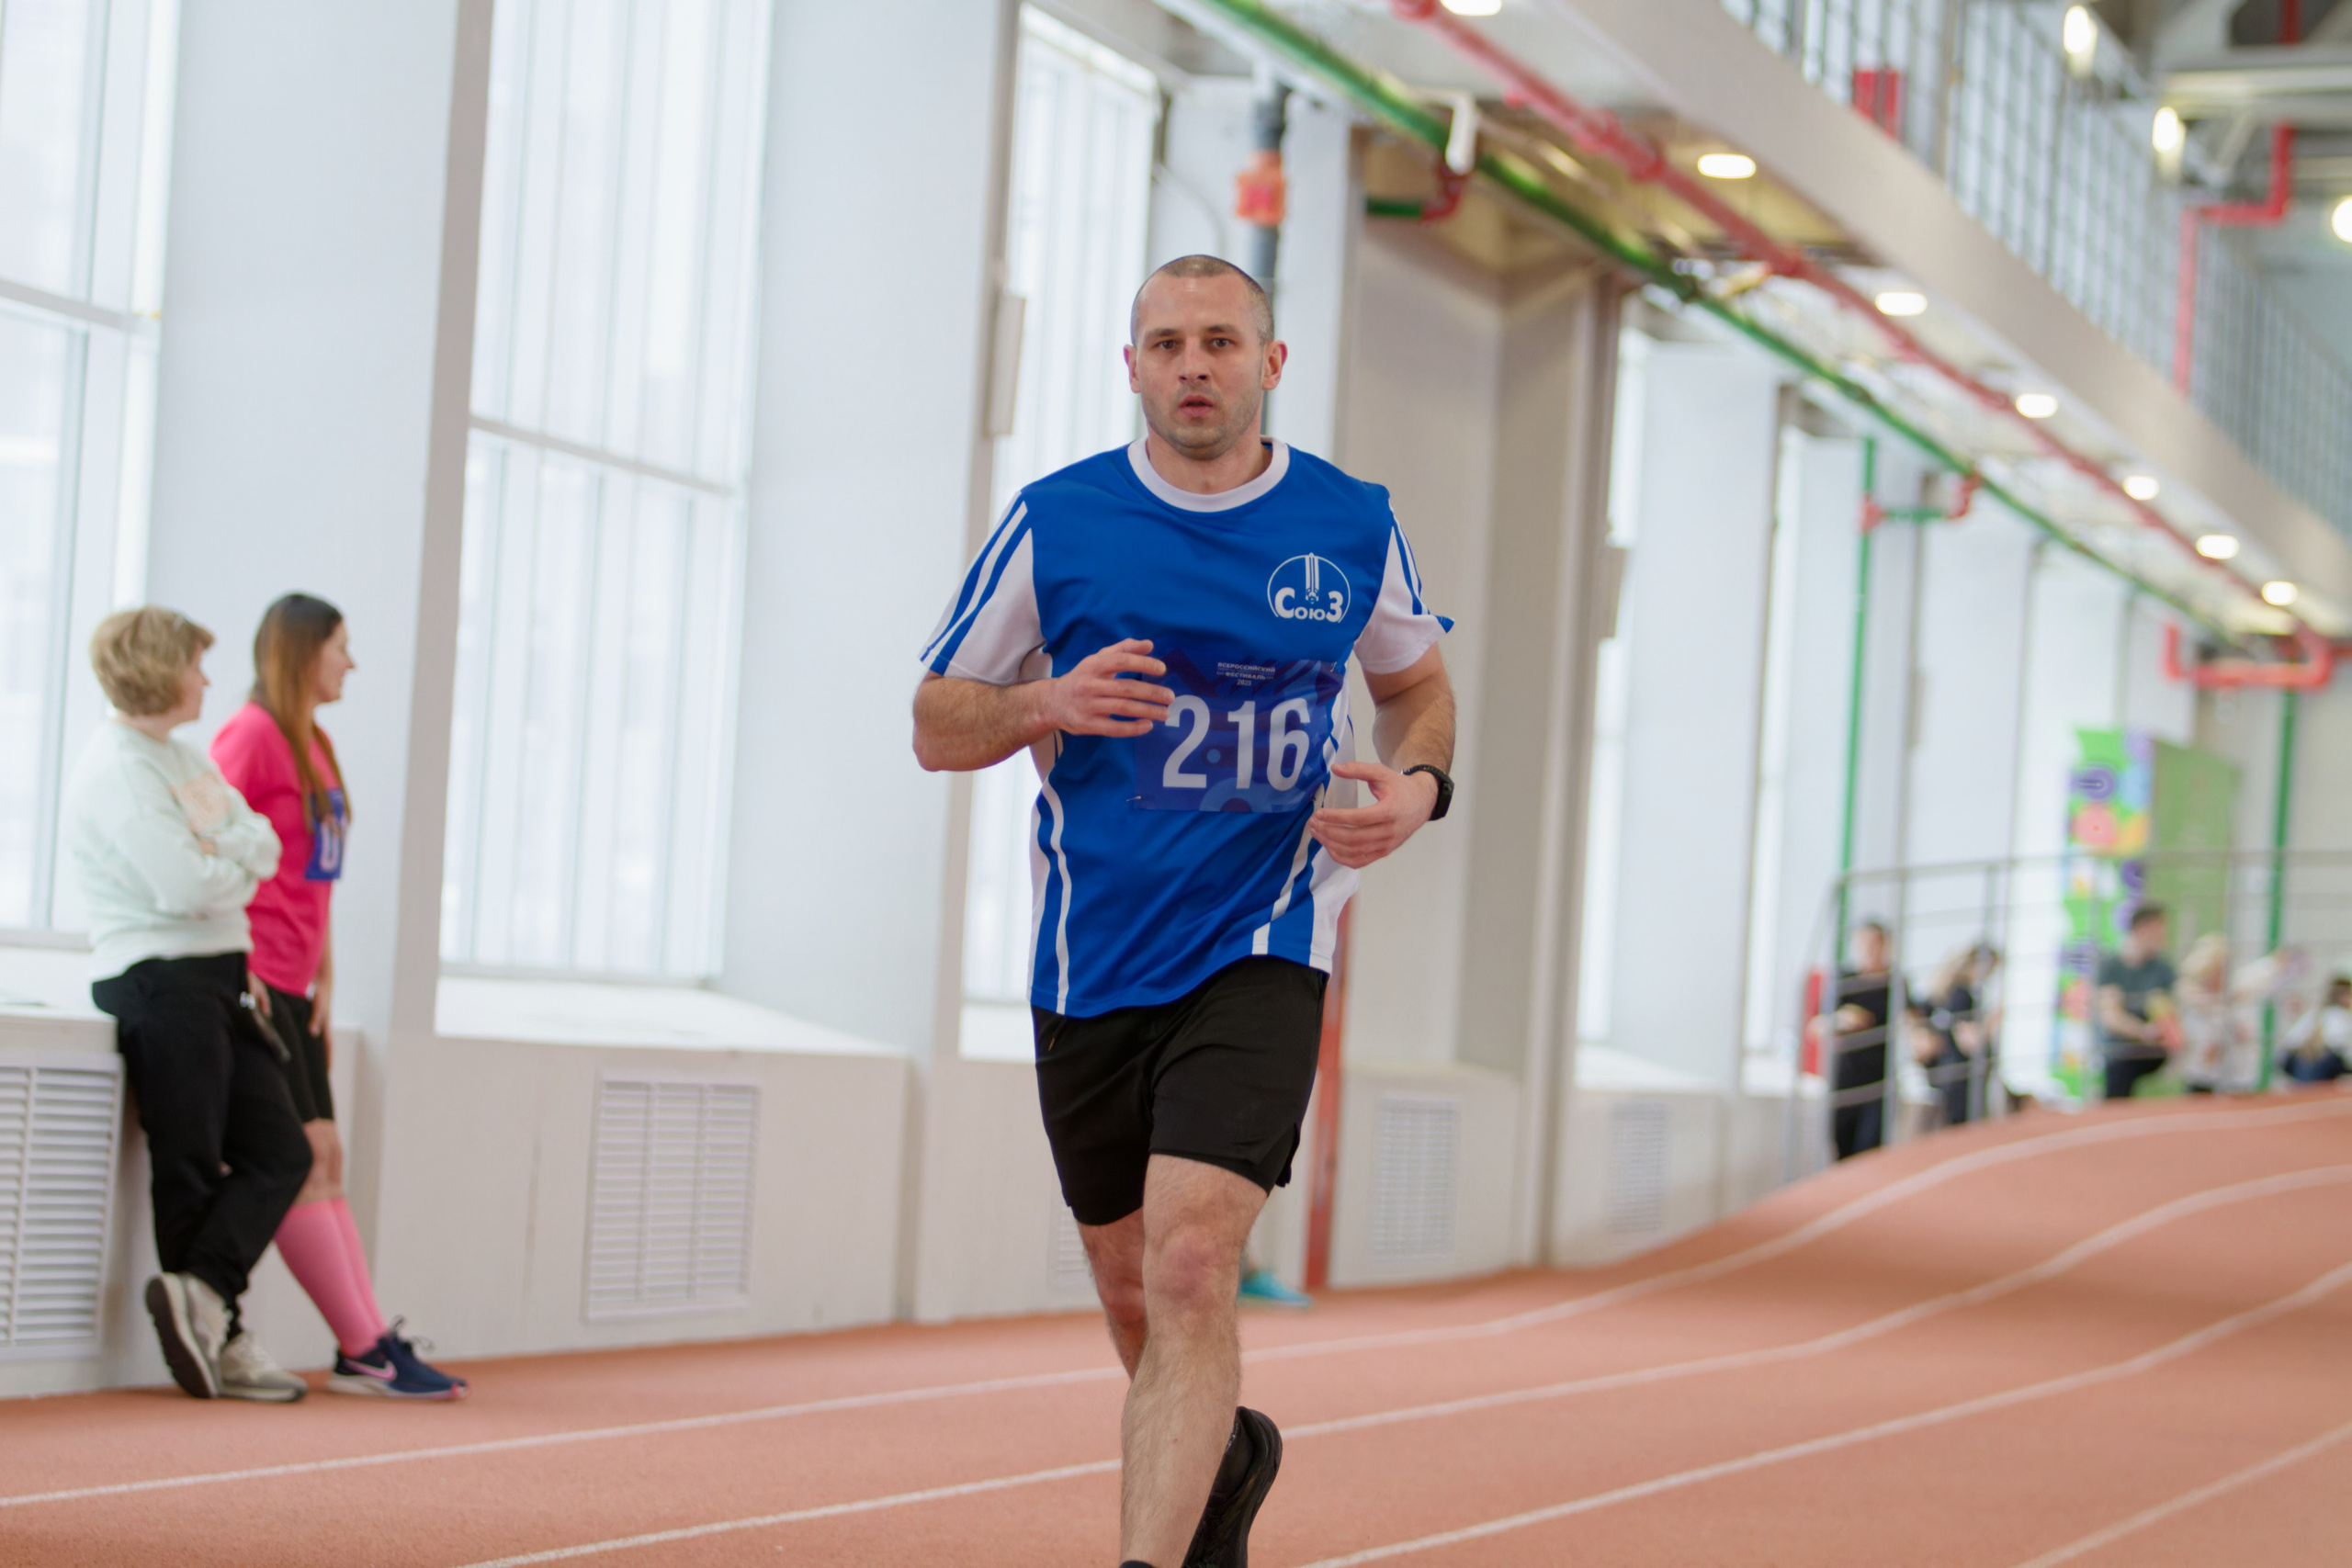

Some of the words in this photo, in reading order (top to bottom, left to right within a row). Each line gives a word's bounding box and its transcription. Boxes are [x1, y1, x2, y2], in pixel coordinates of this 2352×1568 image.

[1217, 662, 1276, 672] ВСЕРОССИЙСКИЙ
[1225, 671, 1266, 680] ФЕСТИВАЛЬ
[1162, 694, 1310, 792] 216
